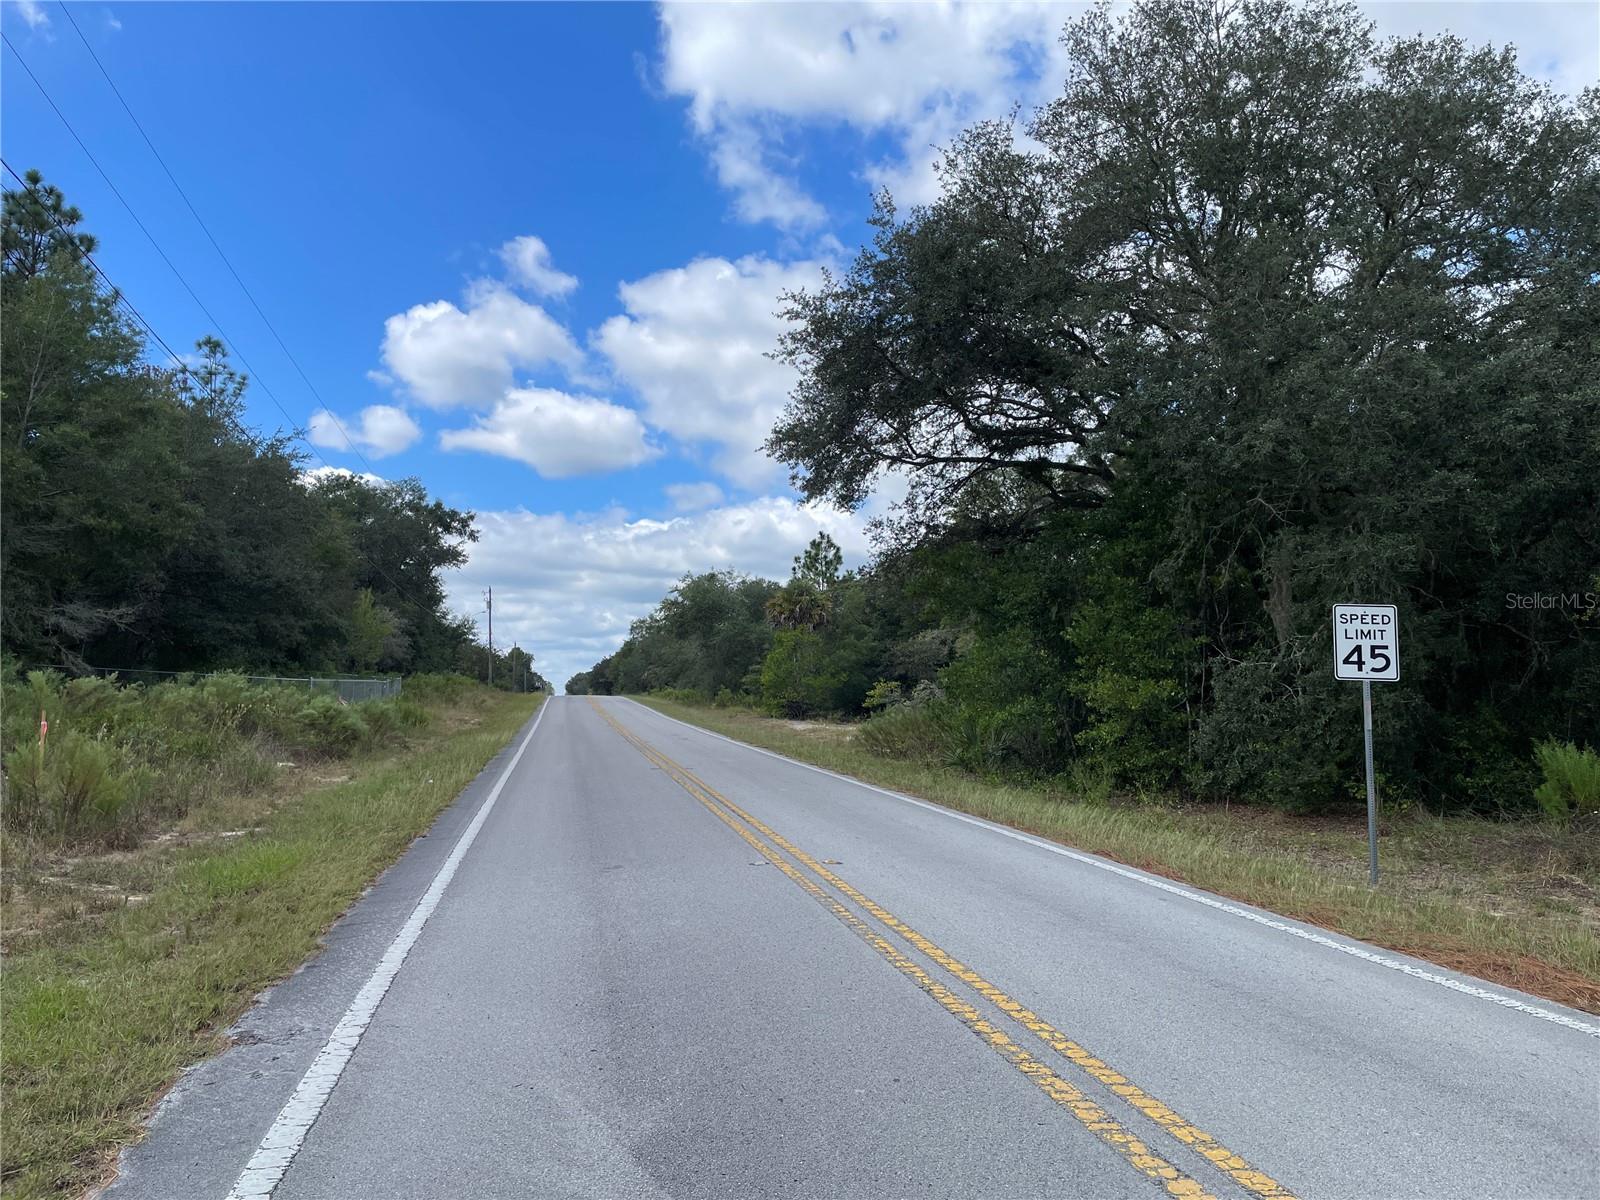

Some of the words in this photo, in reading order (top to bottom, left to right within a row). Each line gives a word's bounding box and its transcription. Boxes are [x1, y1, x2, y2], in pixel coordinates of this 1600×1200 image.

[1339, 613, 1391, 625] SPEED
[1344, 628, 1387, 641] LIMIT
[1342, 644, 1391, 673] 45
